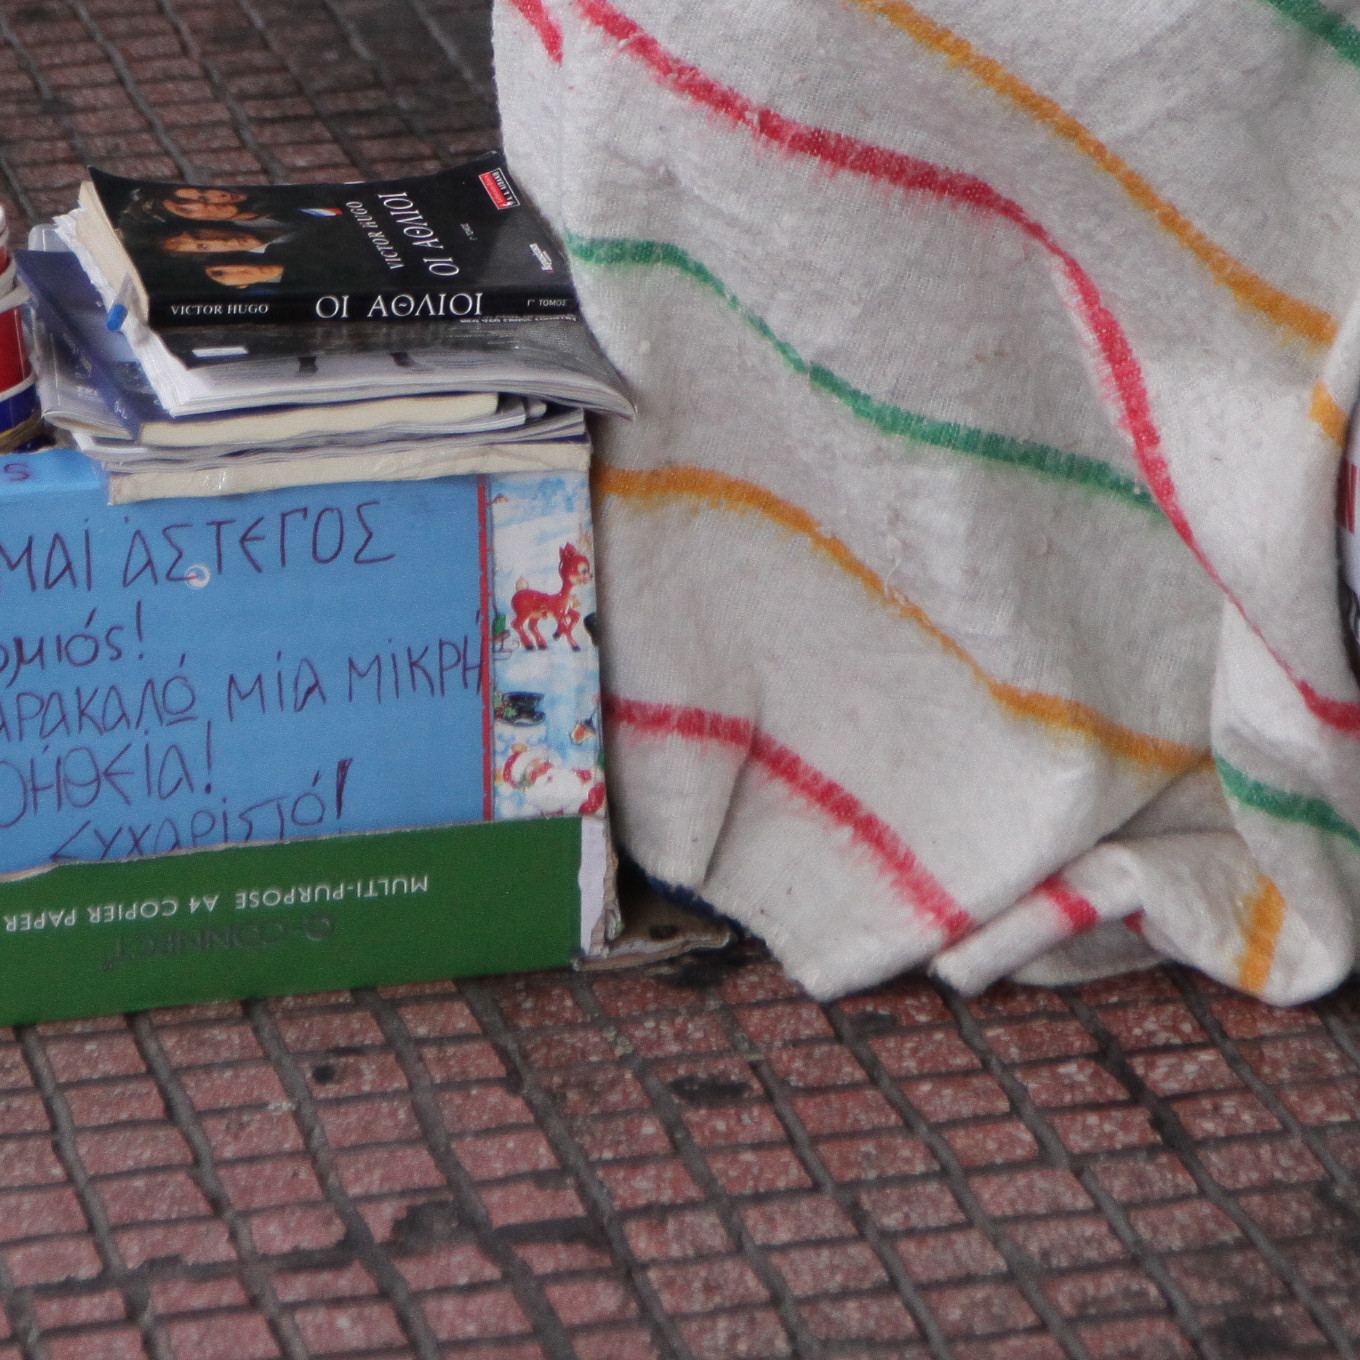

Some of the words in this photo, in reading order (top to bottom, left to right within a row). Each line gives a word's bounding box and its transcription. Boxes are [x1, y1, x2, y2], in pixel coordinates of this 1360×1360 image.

[344, 201, 379, 229] HUGO
[367, 231, 405, 270] VICTOR
[170, 304, 224, 316] VICTOR
[227, 303, 270, 315] HUGO
[367, 292, 484, 318] ΑΘΛΙΟΙ
[189, 894, 220, 913] A4
[234, 874, 429, 911] MULTI-PURPOSE
[3, 906, 78, 933] PAPER
[88, 899, 178, 925] COPIER
